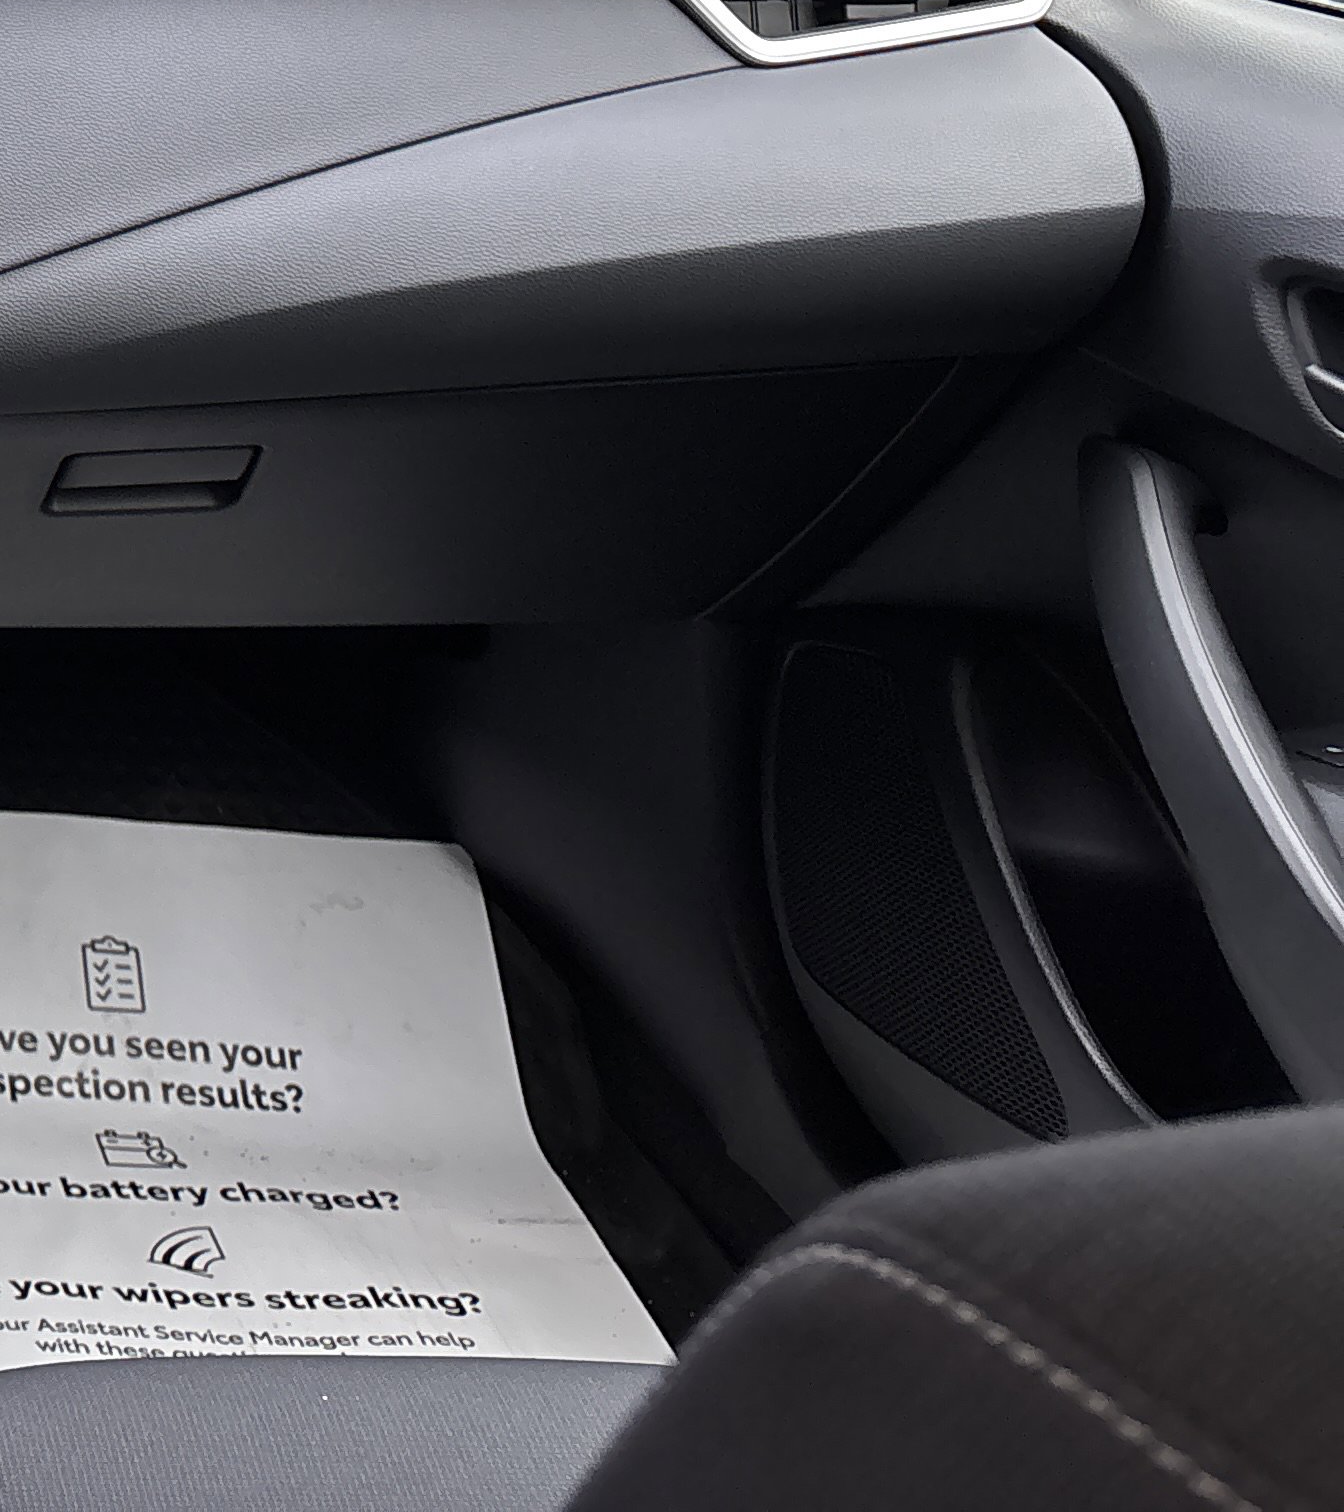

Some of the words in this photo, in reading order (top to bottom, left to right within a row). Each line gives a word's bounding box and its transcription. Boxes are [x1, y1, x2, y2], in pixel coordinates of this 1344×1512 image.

[48, 1030, 115, 1061] you
[126, 1034, 211, 1064] seen
[219, 1040, 303, 1073] your
[160, 1079, 304, 1113] results?
[59, 1176, 209, 1206] battery
[219, 1182, 400, 1211] charged?
[8, 1278, 104, 1300] your
[112, 1282, 256, 1309] wipers
[264, 1286, 481, 1316] streaking?
[35, 1338, 90, 1355] with
[95, 1341, 165, 1358] these
[37, 1318, 150, 1338] Assistant
[154, 1325, 244, 1346] Service
[248, 1330, 360, 1351] Manager
[367, 1335, 413, 1347] can
[416, 1330, 476, 1351] help
